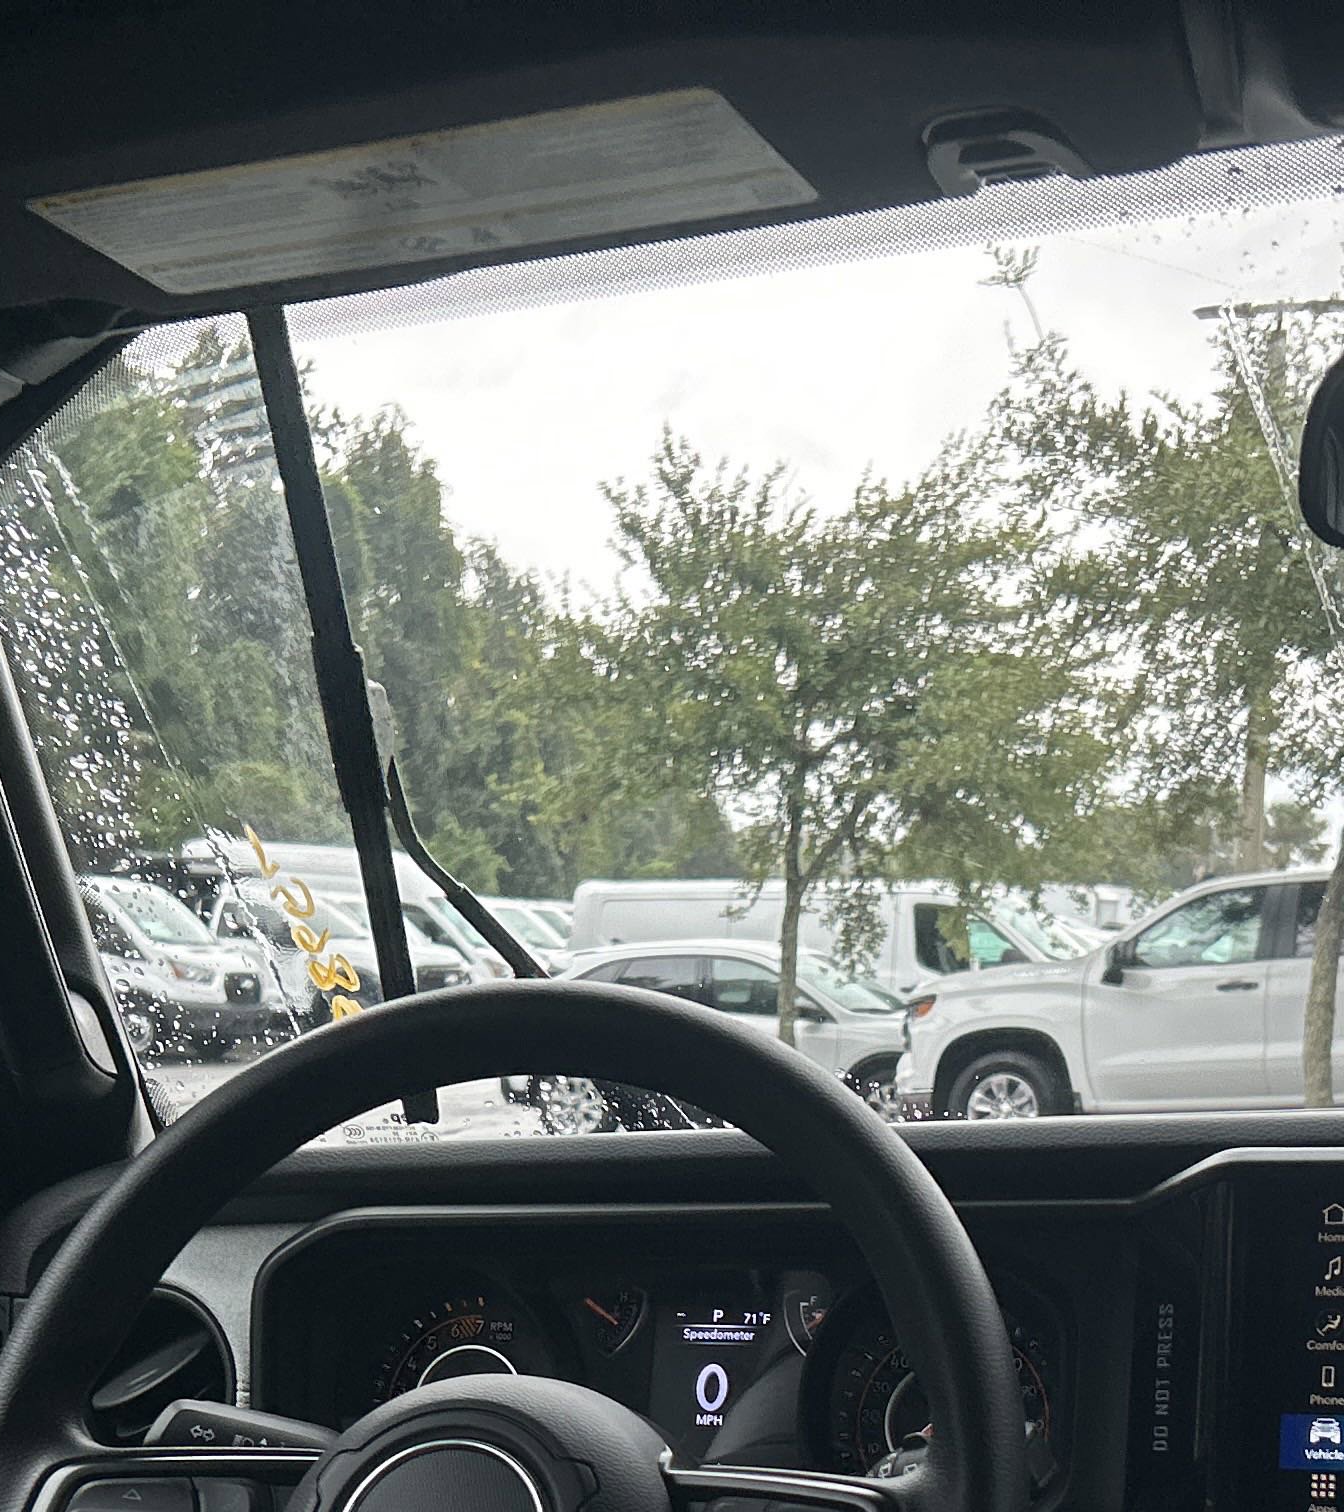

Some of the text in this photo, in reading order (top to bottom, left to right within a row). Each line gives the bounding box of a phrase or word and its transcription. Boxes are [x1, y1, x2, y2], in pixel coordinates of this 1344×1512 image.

[712, 1308, 771, 1325] P 71°F
[451, 1324, 460, 1338] 6
[475, 1320, 485, 1335] 7
[489, 1321, 513, 1332] RPM
[683, 1328, 756, 1341] Speedometer
[426, 1335, 439, 1350] 5
[1152, 1303, 1174, 1452] DO NOT PRESS
[696, 1363, 729, 1412] 0
[1309, 1394, 1344, 1406] Phone
[695, 1413, 723, 1426] MPH
[1304, 1449, 1344, 1461] Vehicle
